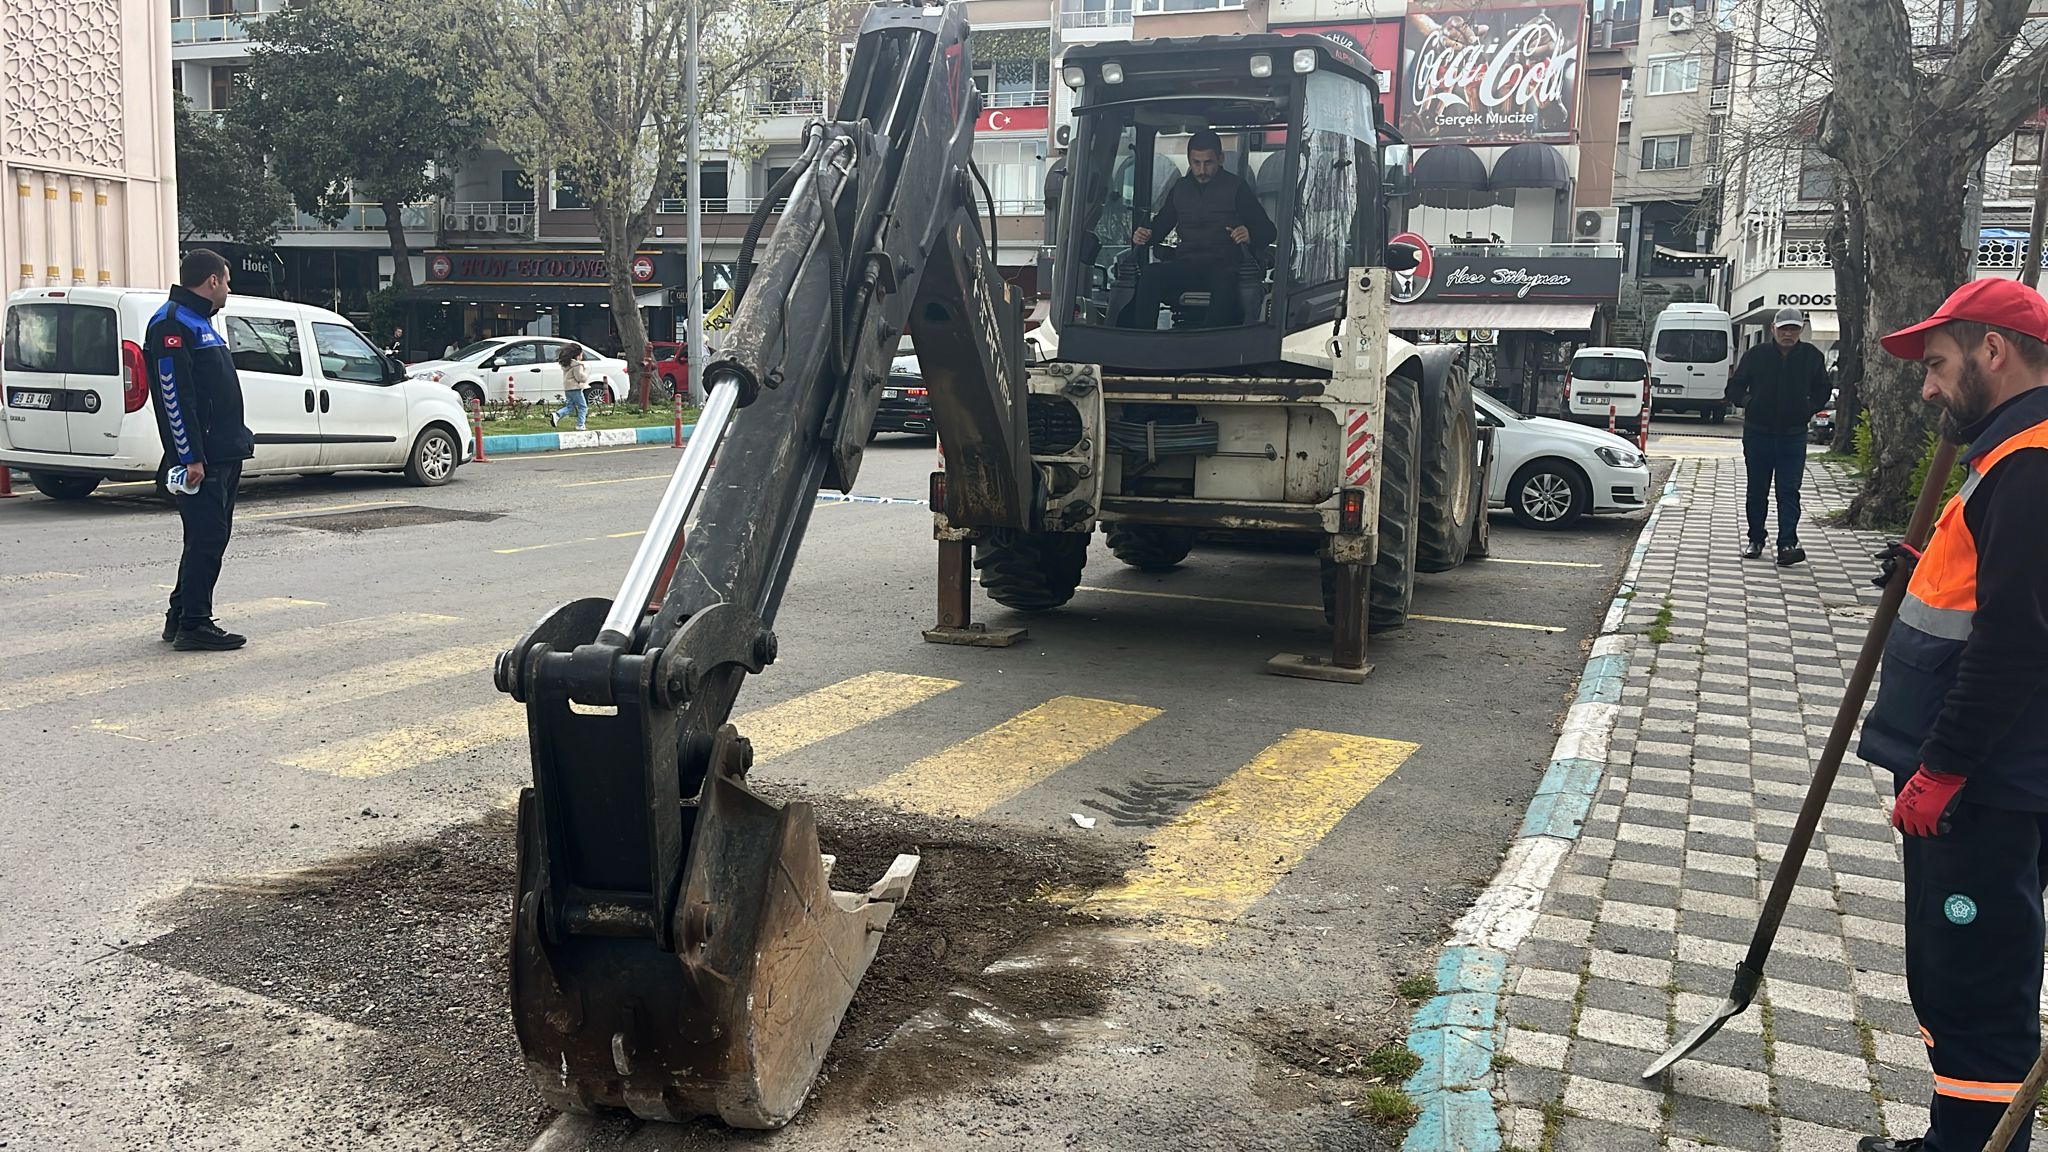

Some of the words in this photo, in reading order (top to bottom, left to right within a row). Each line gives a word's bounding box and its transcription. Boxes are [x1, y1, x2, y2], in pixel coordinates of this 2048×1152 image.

[1412, 22, 1567, 107] Coca-Cola
[1435, 114, 1483, 127] Gerçek
[1486, 112, 1536, 125] Mucize
[546, 255, 608, 279] DÖNE
[1490, 268, 1571, 298] Süleyman
[1778, 294, 1836, 305] RODOS
